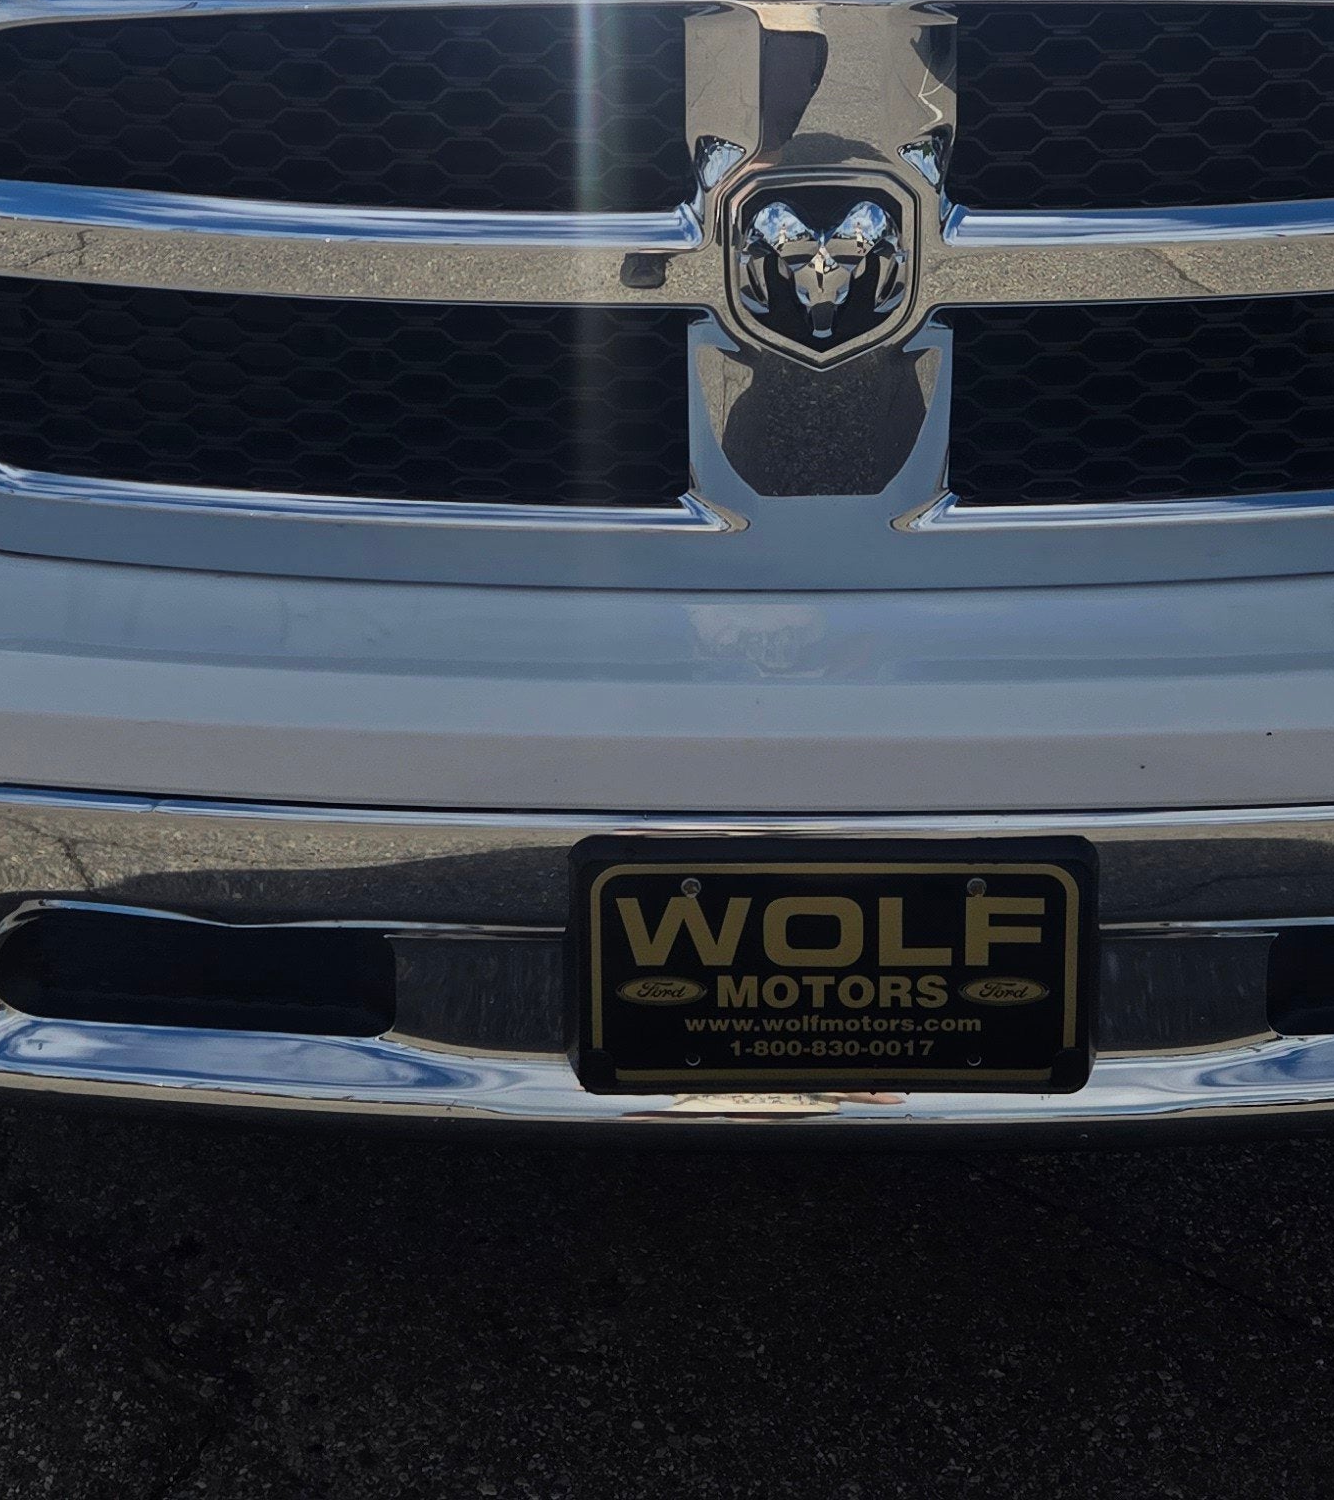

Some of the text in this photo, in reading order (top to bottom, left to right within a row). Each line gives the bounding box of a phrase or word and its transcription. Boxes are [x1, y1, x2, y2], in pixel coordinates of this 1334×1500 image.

[616, 896, 1046, 968] WOLF
[717, 974, 949, 1009] MOTORS
[684, 1015, 982, 1032] www.wolfmotors.com
[730, 1040, 935, 1057] 1-800-830-0017
